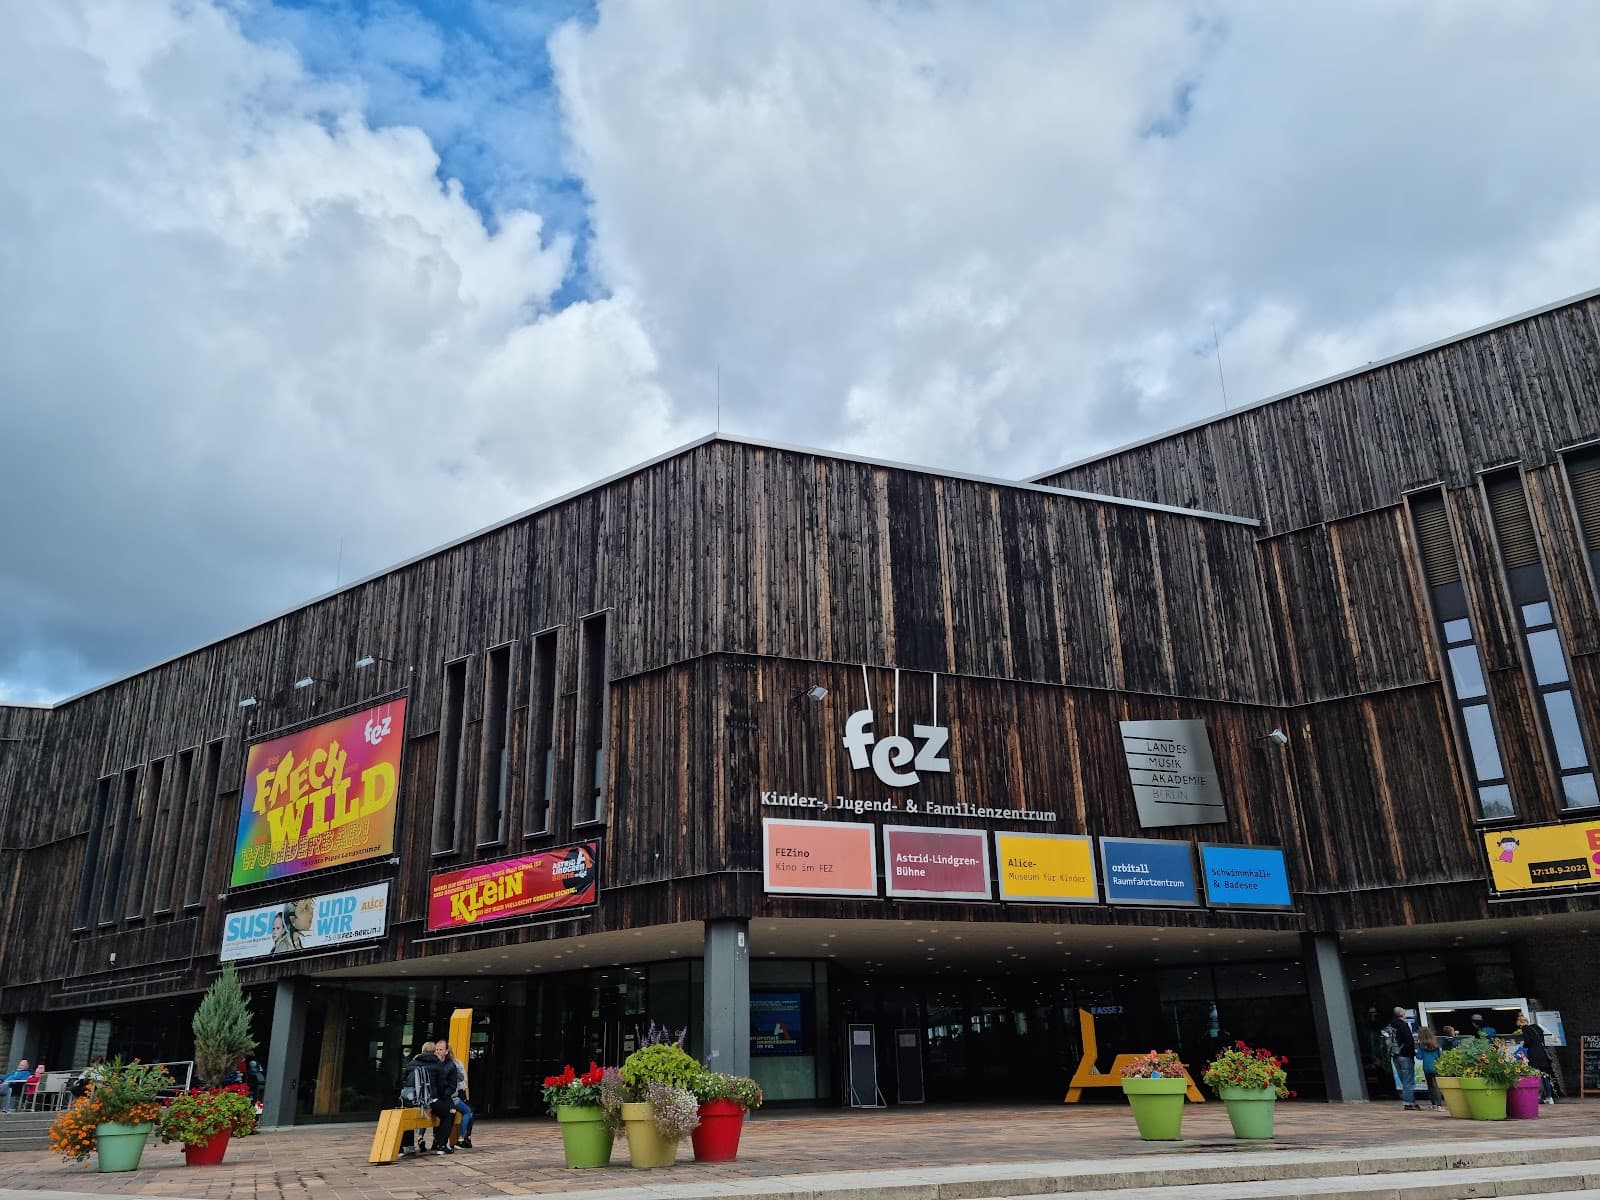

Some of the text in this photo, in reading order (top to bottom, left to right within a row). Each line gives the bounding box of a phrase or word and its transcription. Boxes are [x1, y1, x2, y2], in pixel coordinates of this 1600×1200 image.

[842, 709, 950, 787] fez
[1147, 742, 1187, 754] LANDES
[1149, 757, 1182, 769] MUSIK
[1152, 773, 1208, 786] AKADEMIE
[1153, 789, 1188, 801] BERLIN
[267, 761, 396, 848] WILD
[761, 792, 1057, 821] Kinder-, Jugend- & Familienzentrum
[775, 847, 810, 858] FEZino
[896, 852, 980, 866] Astrid-Lindgren-
[1008, 858, 1037, 868] Alice-
[775, 863, 833, 873] Kino im FEZ
[896, 866, 926, 877] Bühne
[1112, 863, 1149, 873] orbitall
[1211, 867, 1272, 878] Schwimmhalle
[1008, 872, 1087, 883] Museum für Kinder
[1112, 876, 1185, 887] Raumfahrtzentrum
[1213, 879, 1259, 890] & Badesee
[226, 910, 277, 942] SUSI
[317, 914, 353, 937] WIR
